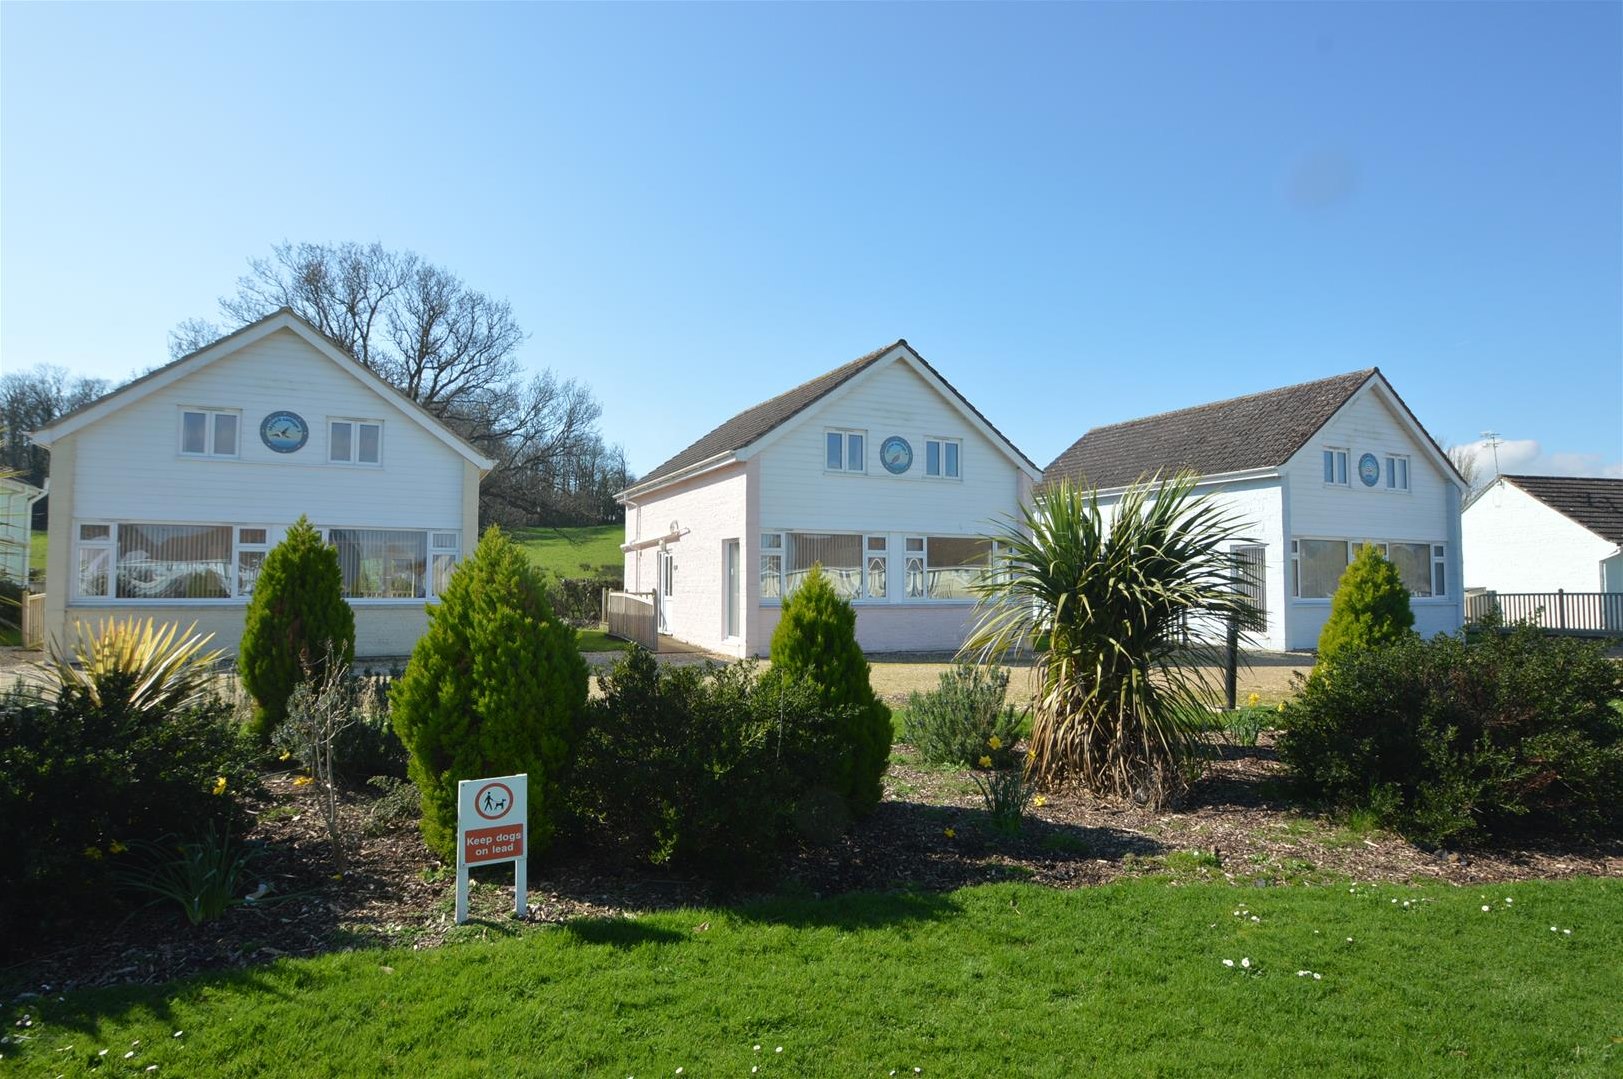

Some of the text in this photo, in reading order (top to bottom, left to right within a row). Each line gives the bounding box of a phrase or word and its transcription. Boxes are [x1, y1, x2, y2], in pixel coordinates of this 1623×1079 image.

[467, 832, 521, 846] Keep dogs
[475, 843, 514, 856] on lead
